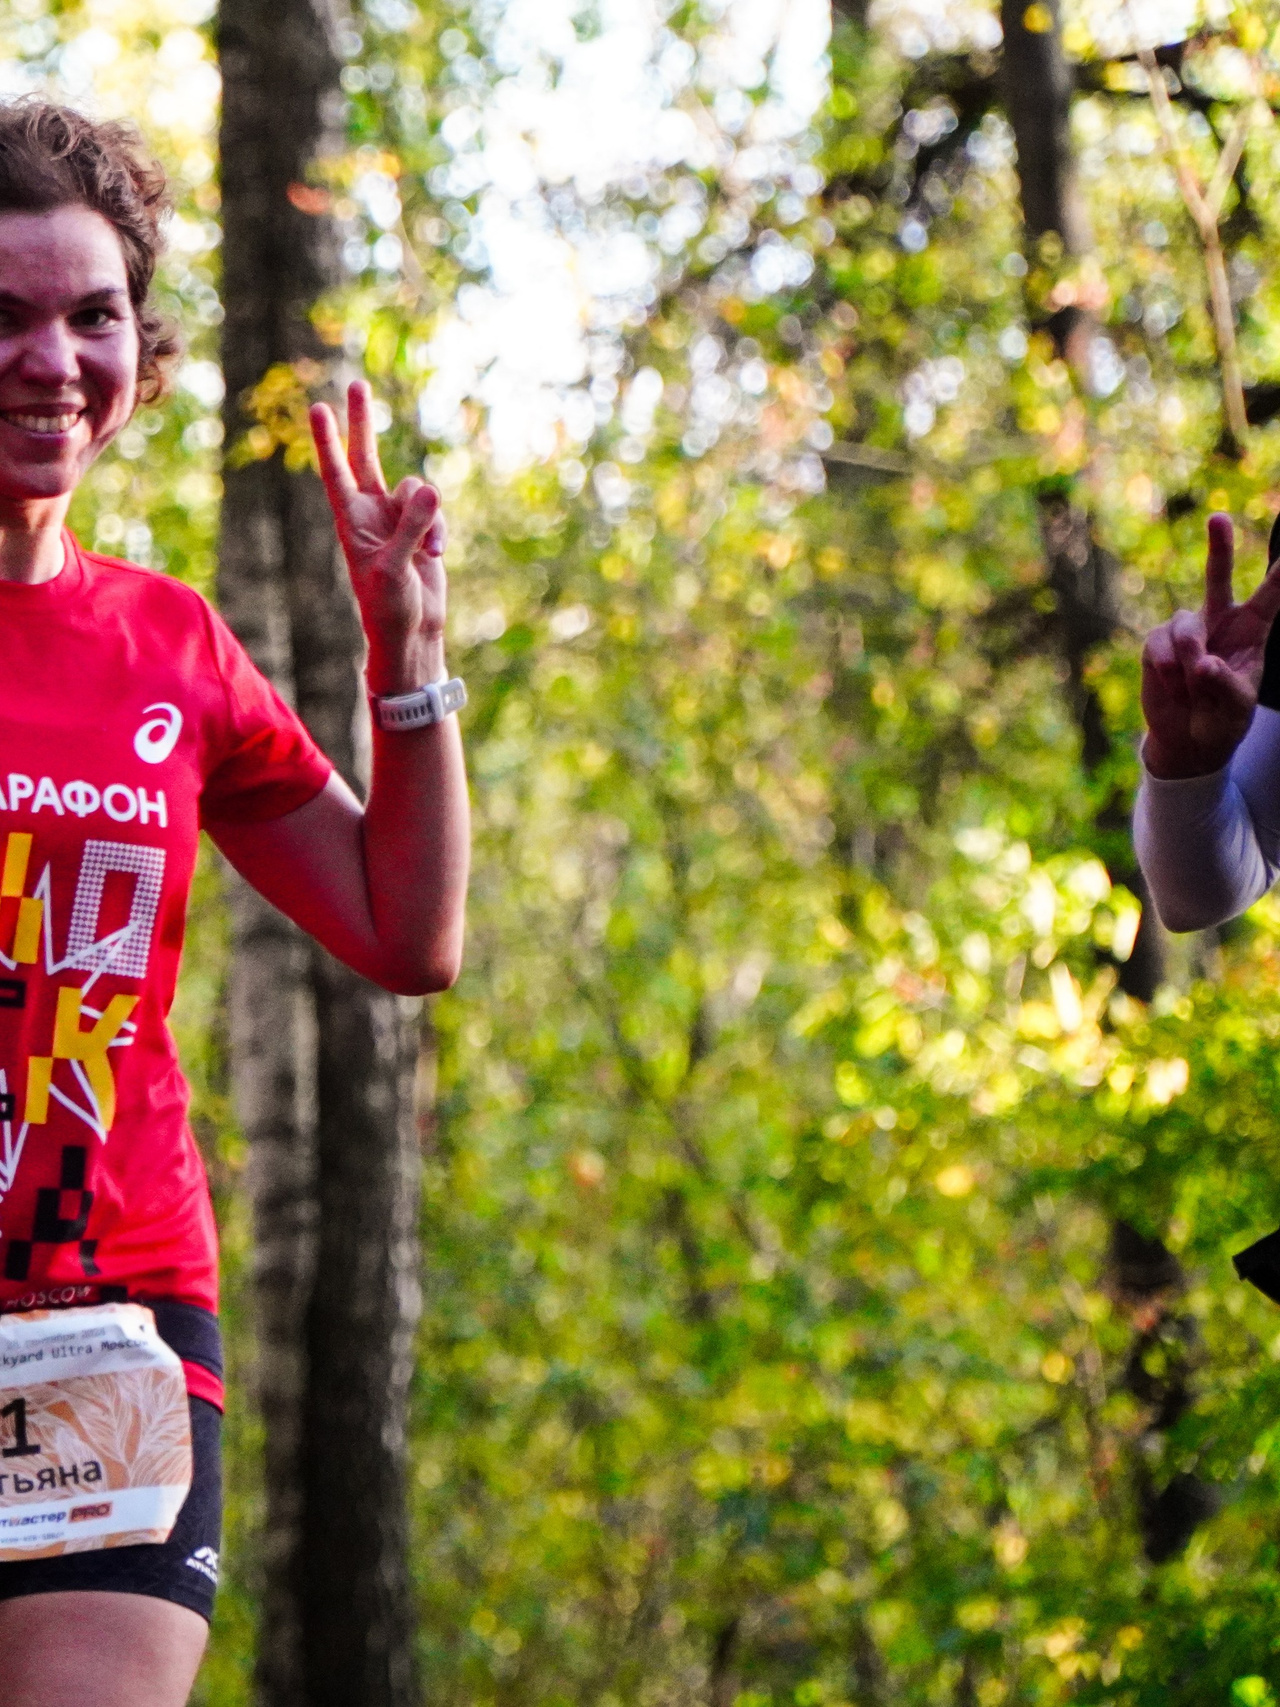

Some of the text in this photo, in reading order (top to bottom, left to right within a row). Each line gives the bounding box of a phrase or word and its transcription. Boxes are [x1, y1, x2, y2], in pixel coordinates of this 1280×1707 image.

[52, 1343, 93, 1359] Ultra
[0, 1397, 41, 1458] 1
[71, 1502, 112, 1522] PRO
